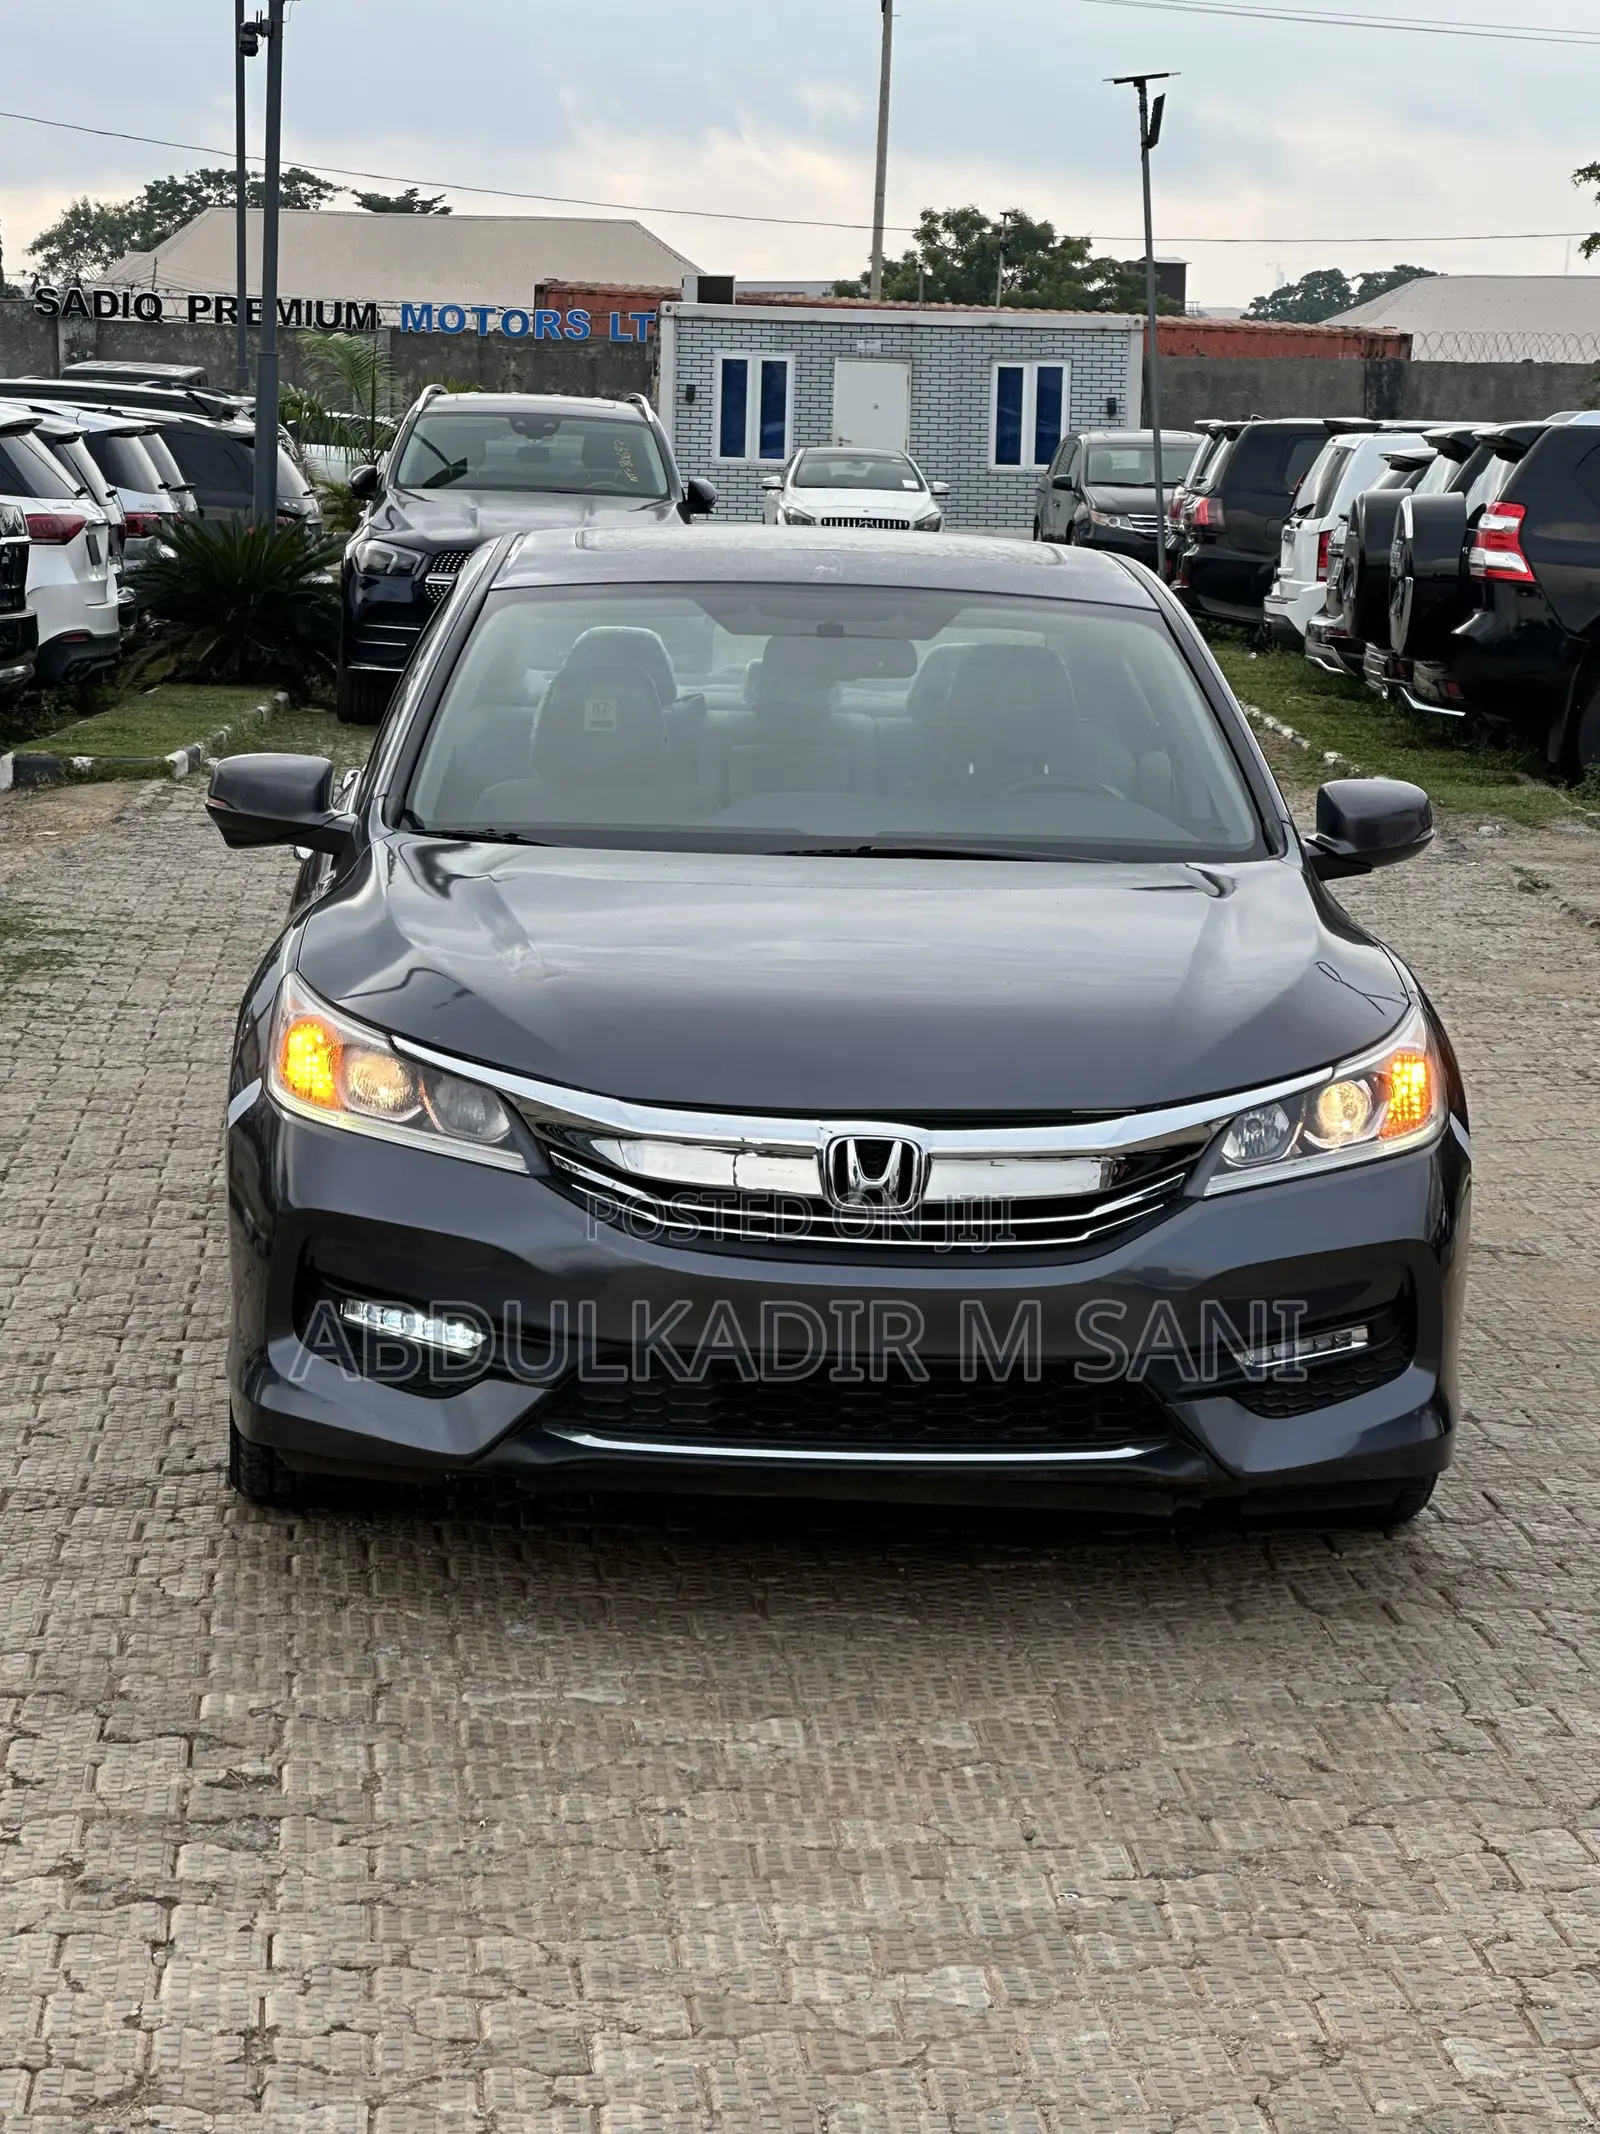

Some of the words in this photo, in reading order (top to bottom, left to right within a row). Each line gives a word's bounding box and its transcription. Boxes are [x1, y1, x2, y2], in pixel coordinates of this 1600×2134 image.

[33, 286, 164, 324] SADIQ
[187, 294, 378, 331] PREMIUM
[400, 302, 591, 341] MOTORS
[609, 311, 657, 342] LT
